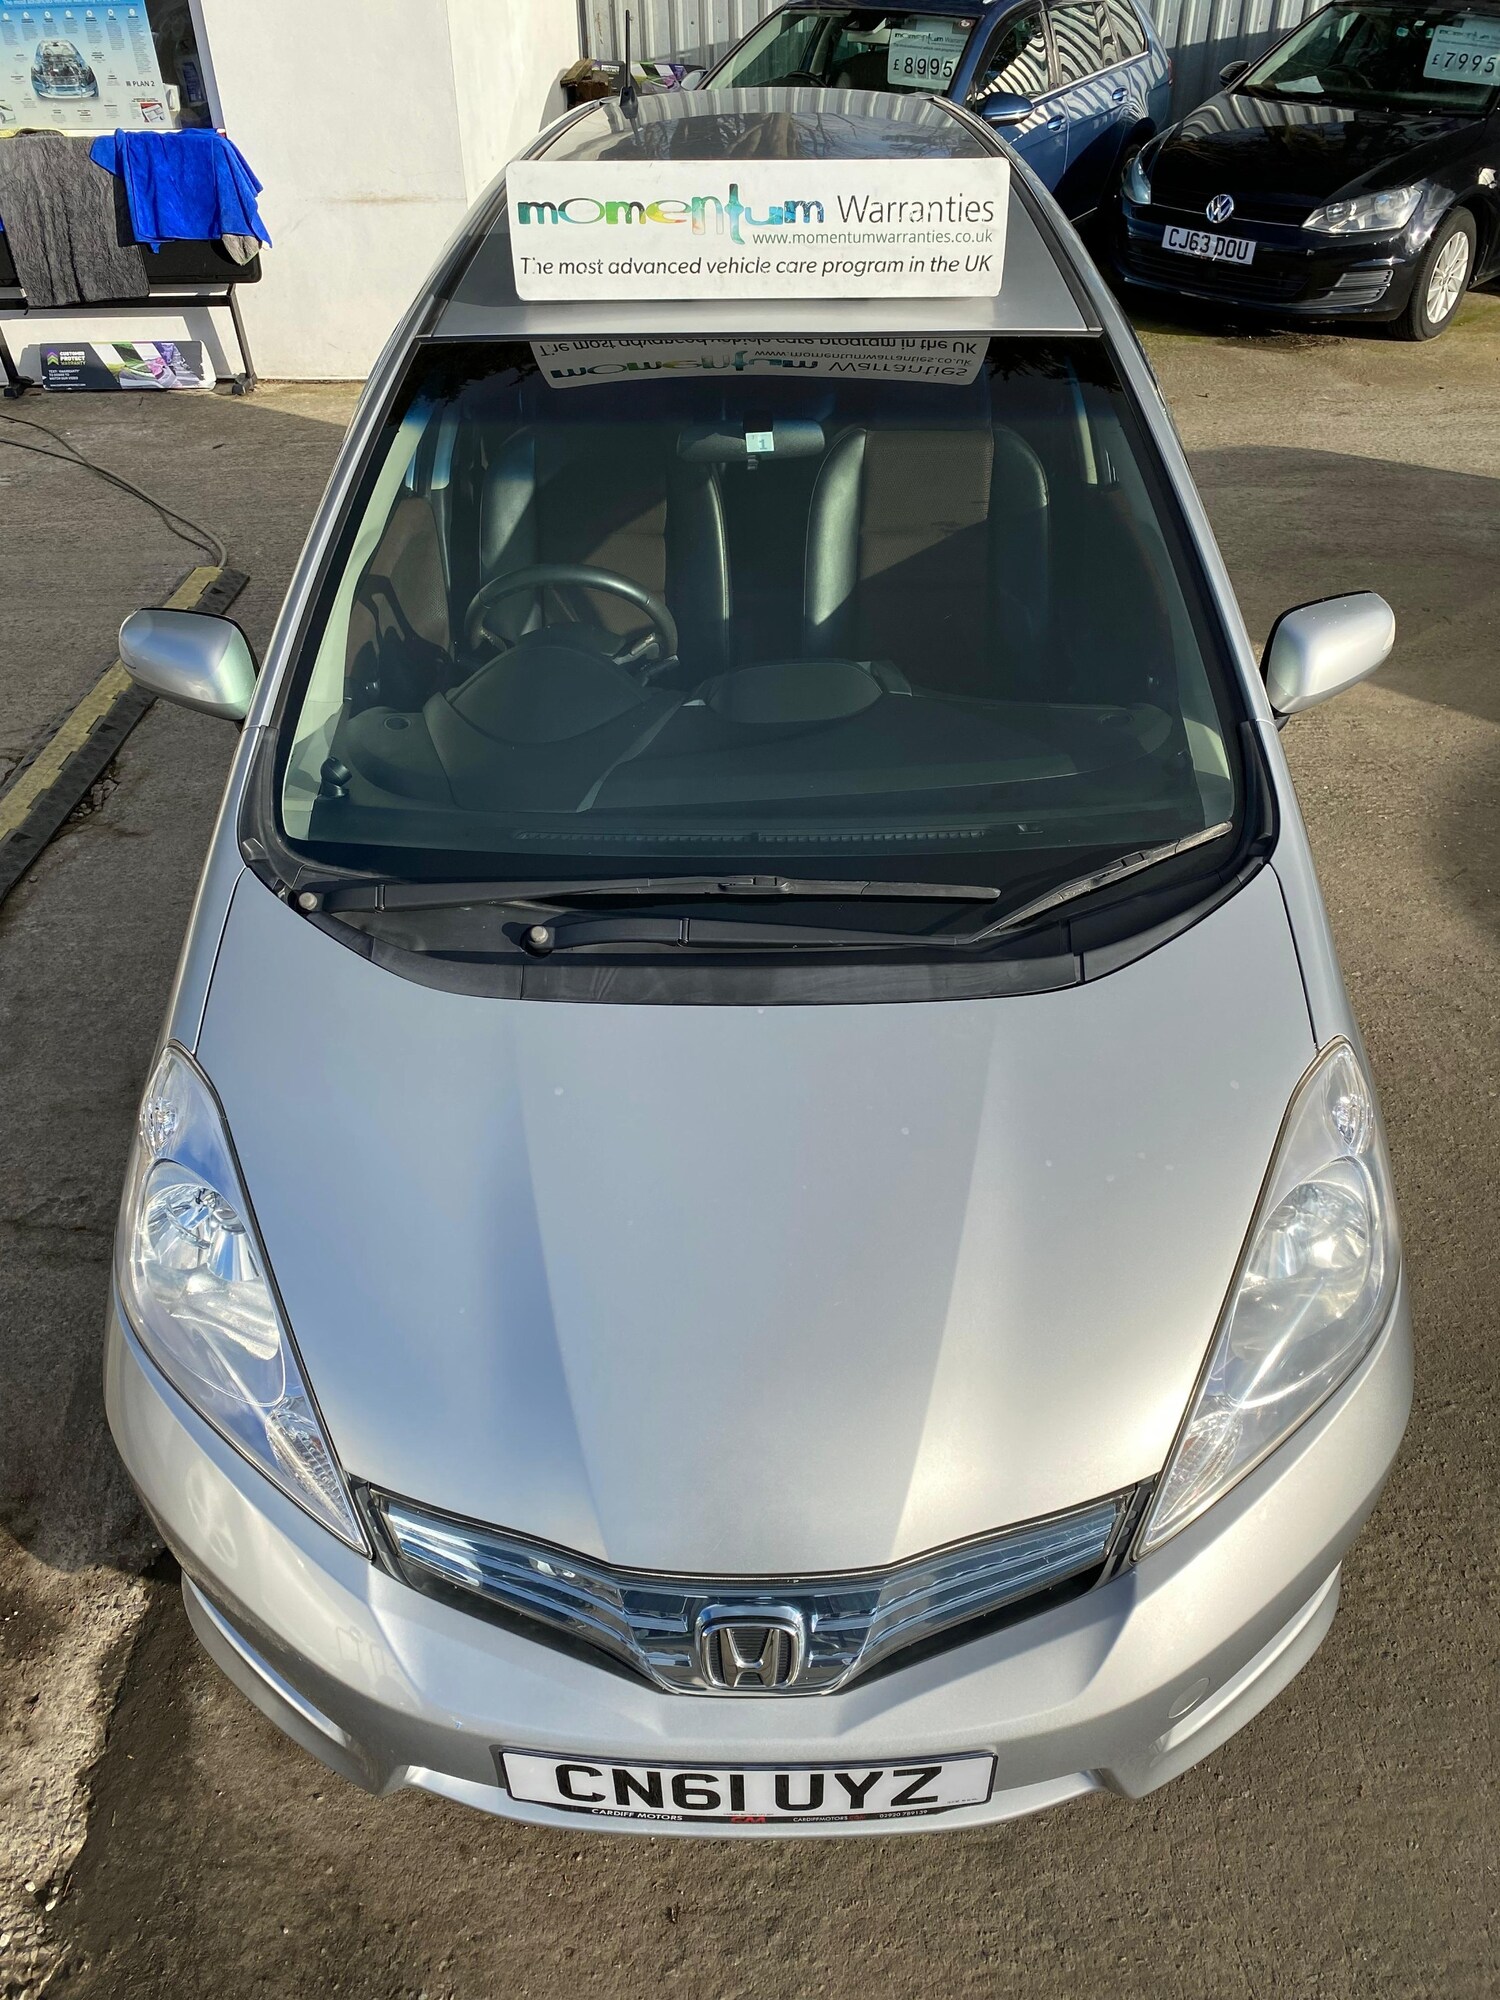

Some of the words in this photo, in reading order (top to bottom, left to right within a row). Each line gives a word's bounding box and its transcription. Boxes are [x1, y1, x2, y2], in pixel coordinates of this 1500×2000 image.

[517, 183, 824, 245] momentum
[837, 193, 994, 223] Warranties
[752, 228, 993, 244] www.momentumwarranties.co.uk
[1168, 228, 1211, 253] CJ63
[1213, 237, 1249, 260] DOU
[559, 258, 604, 274] most
[608, 256, 702, 275] advanced
[707, 256, 771, 274] vehicle
[776, 259, 817, 273] care
[821, 258, 904, 277] program
[909, 255, 925, 272] in
[930, 255, 960, 272] the
[964, 255, 993, 272] UK
[555, 1763, 746, 1812] CN61
[774, 1766, 943, 1811] UYZ
[591, 1808, 635, 1818] CARDIFF
[637, 1812, 683, 1821] MOTORS
